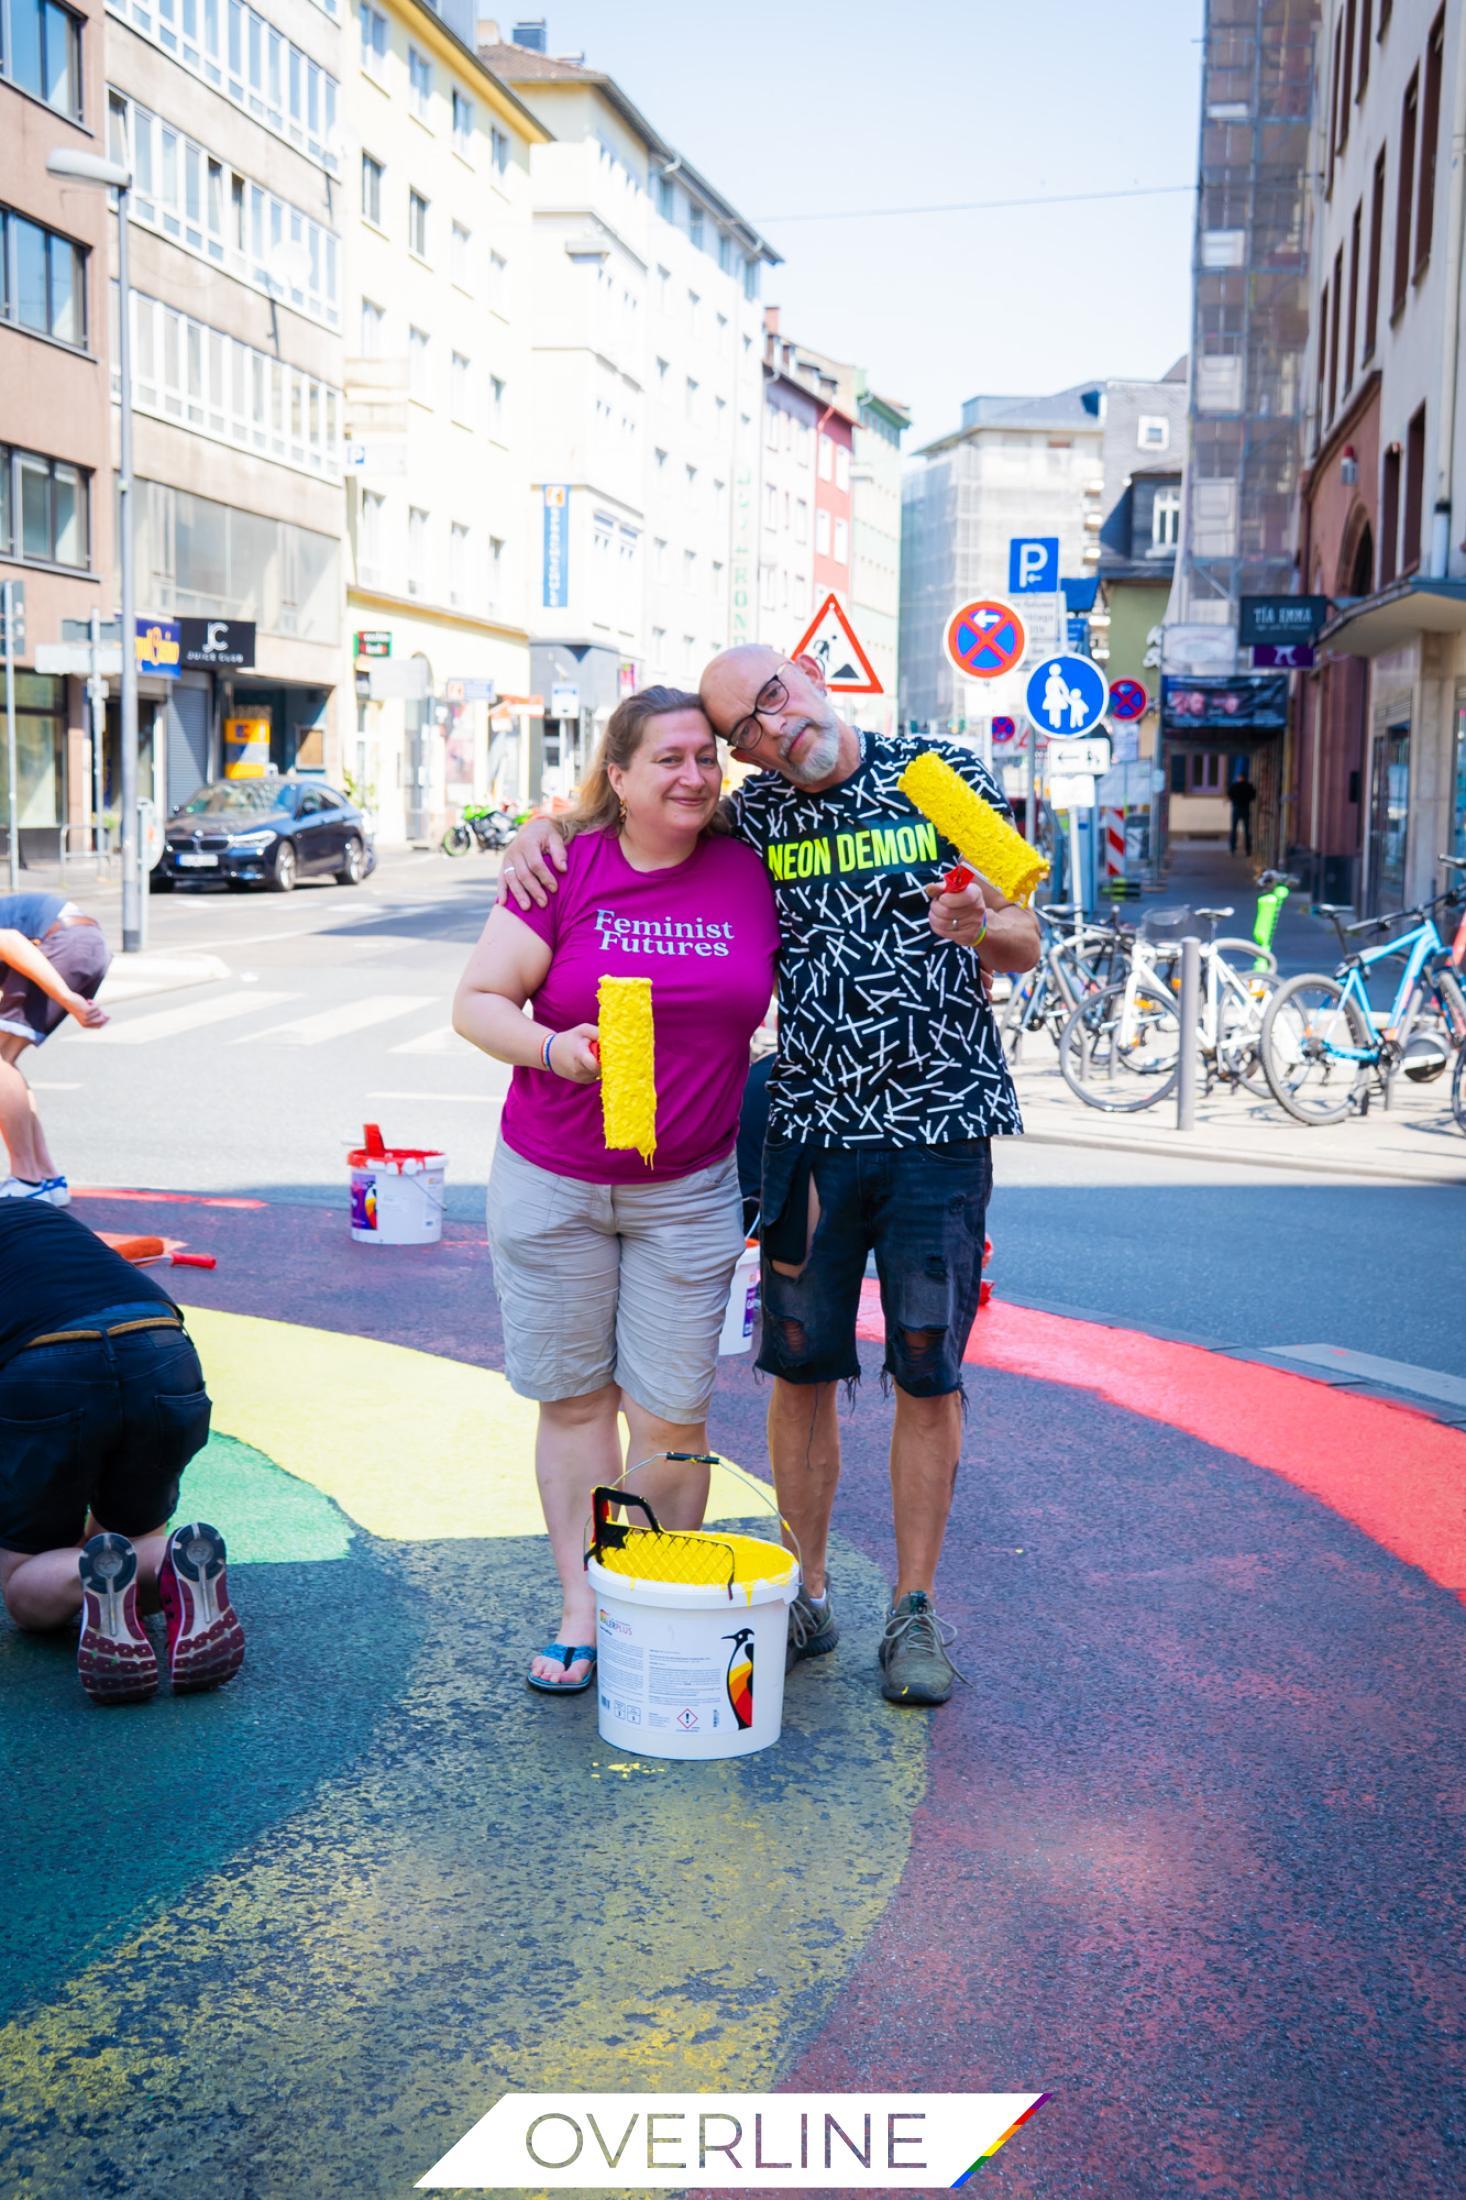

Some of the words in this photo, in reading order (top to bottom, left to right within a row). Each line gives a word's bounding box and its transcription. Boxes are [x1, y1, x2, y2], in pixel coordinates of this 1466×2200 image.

[1019, 543, 1048, 588] P
[1278, 607, 1312, 624] EMMA
[202, 621, 229, 653] JC
[186, 651, 217, 662] JUICE
[218, 652, 244, 663] CLUB
[768, 837, 831, 881] NEON
[836, 823, 938, 873] DEMON
[594, 909, 735, 939] Feminist
[599, 930, 729, 957] Futures
